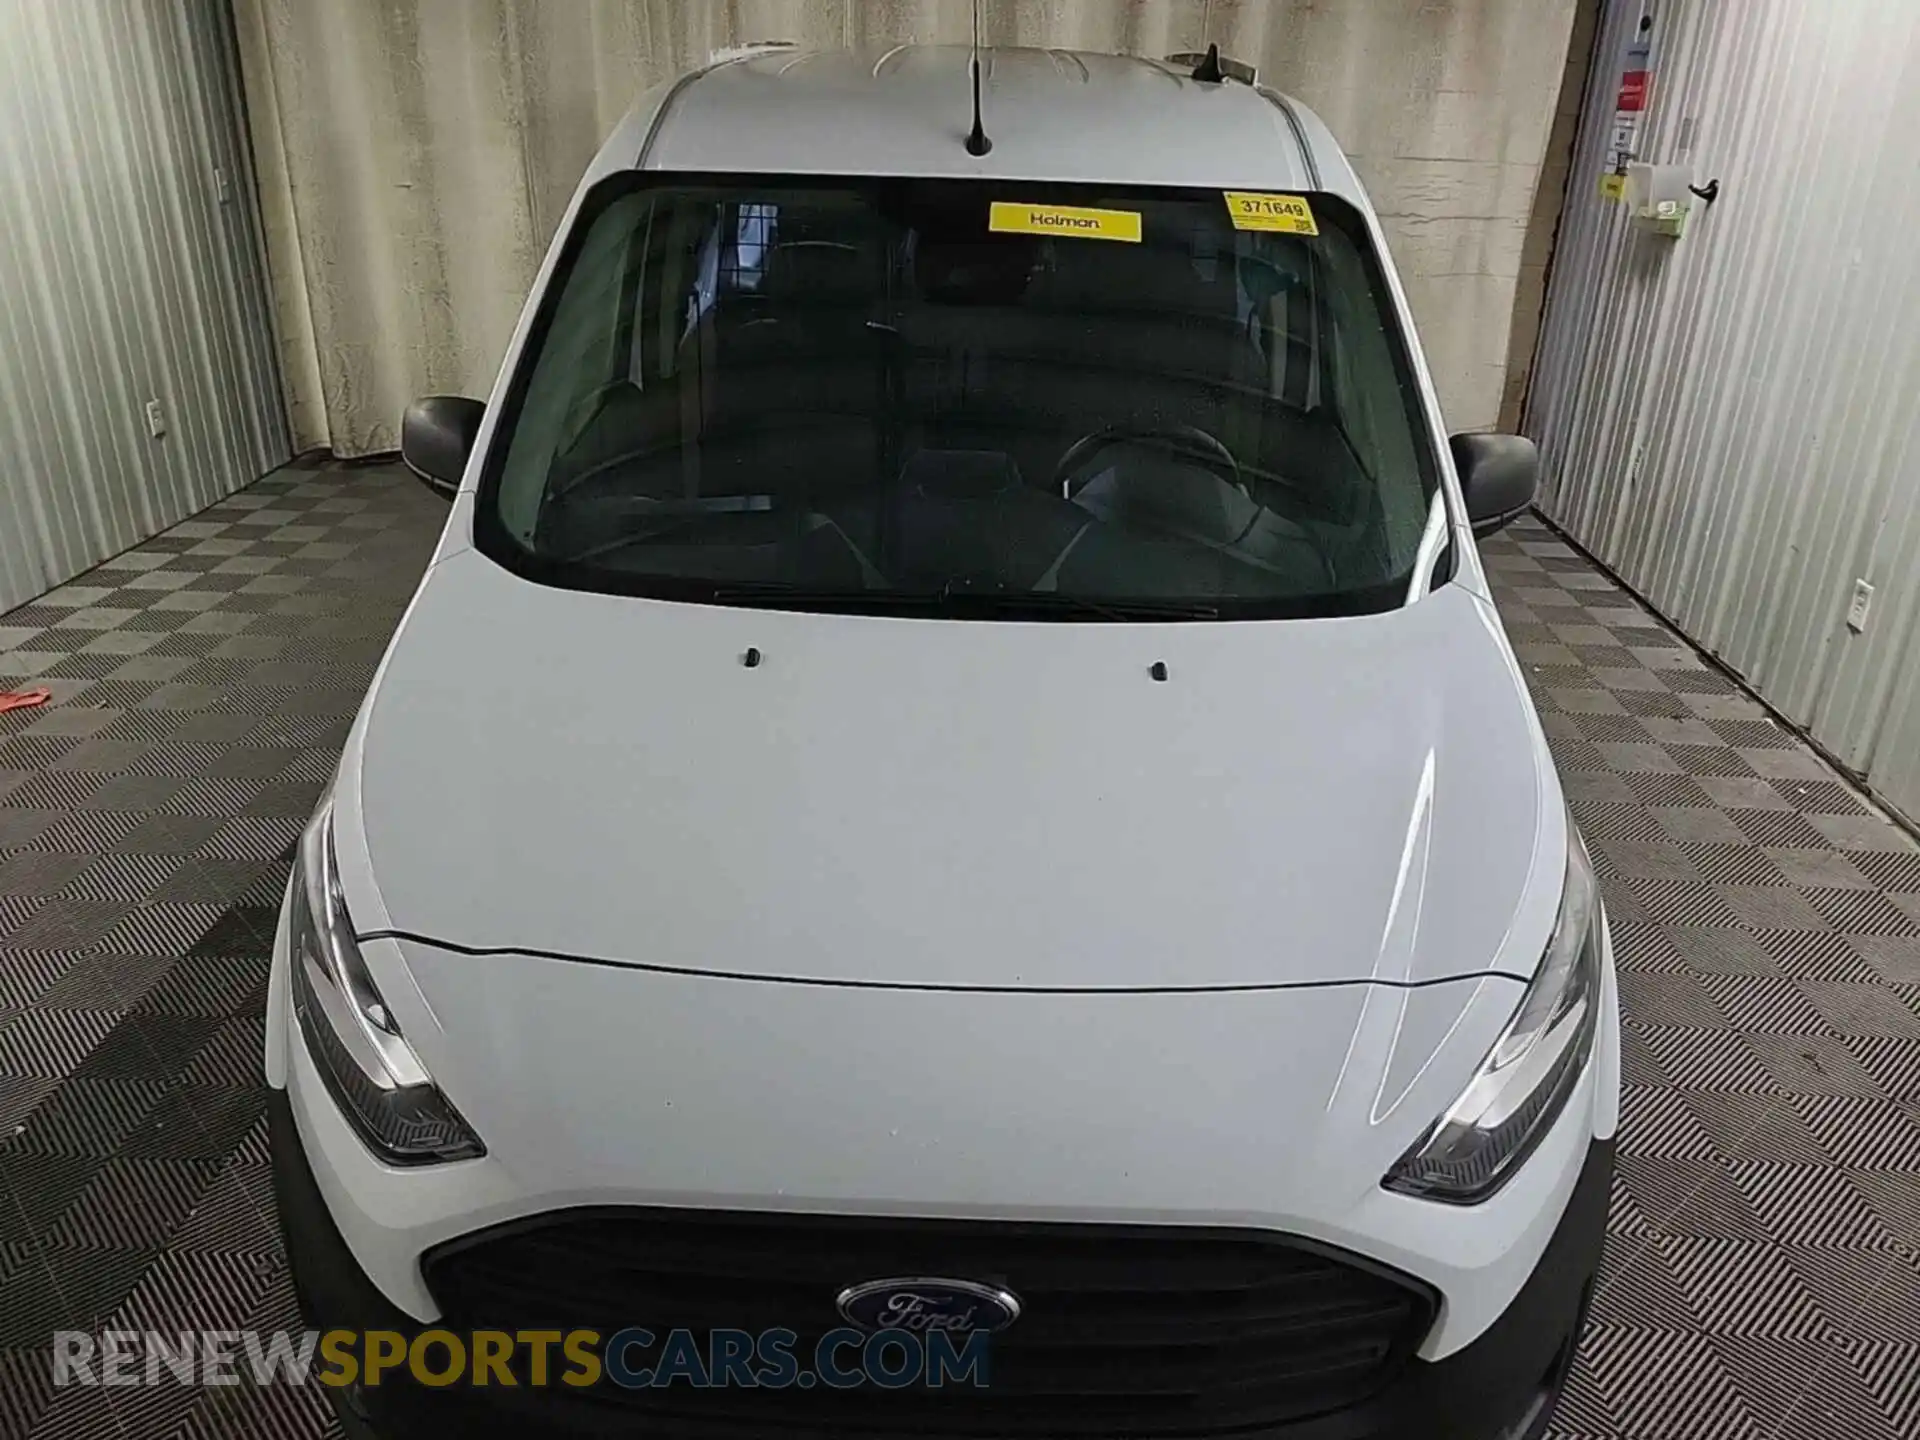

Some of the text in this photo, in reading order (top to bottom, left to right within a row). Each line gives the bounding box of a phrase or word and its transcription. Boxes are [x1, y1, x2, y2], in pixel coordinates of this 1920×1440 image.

[1241, 200, 1304, 217] 371649
[1030, 212, 1101, 229] Holman
[877, 1293, 978, 1331] Ford
